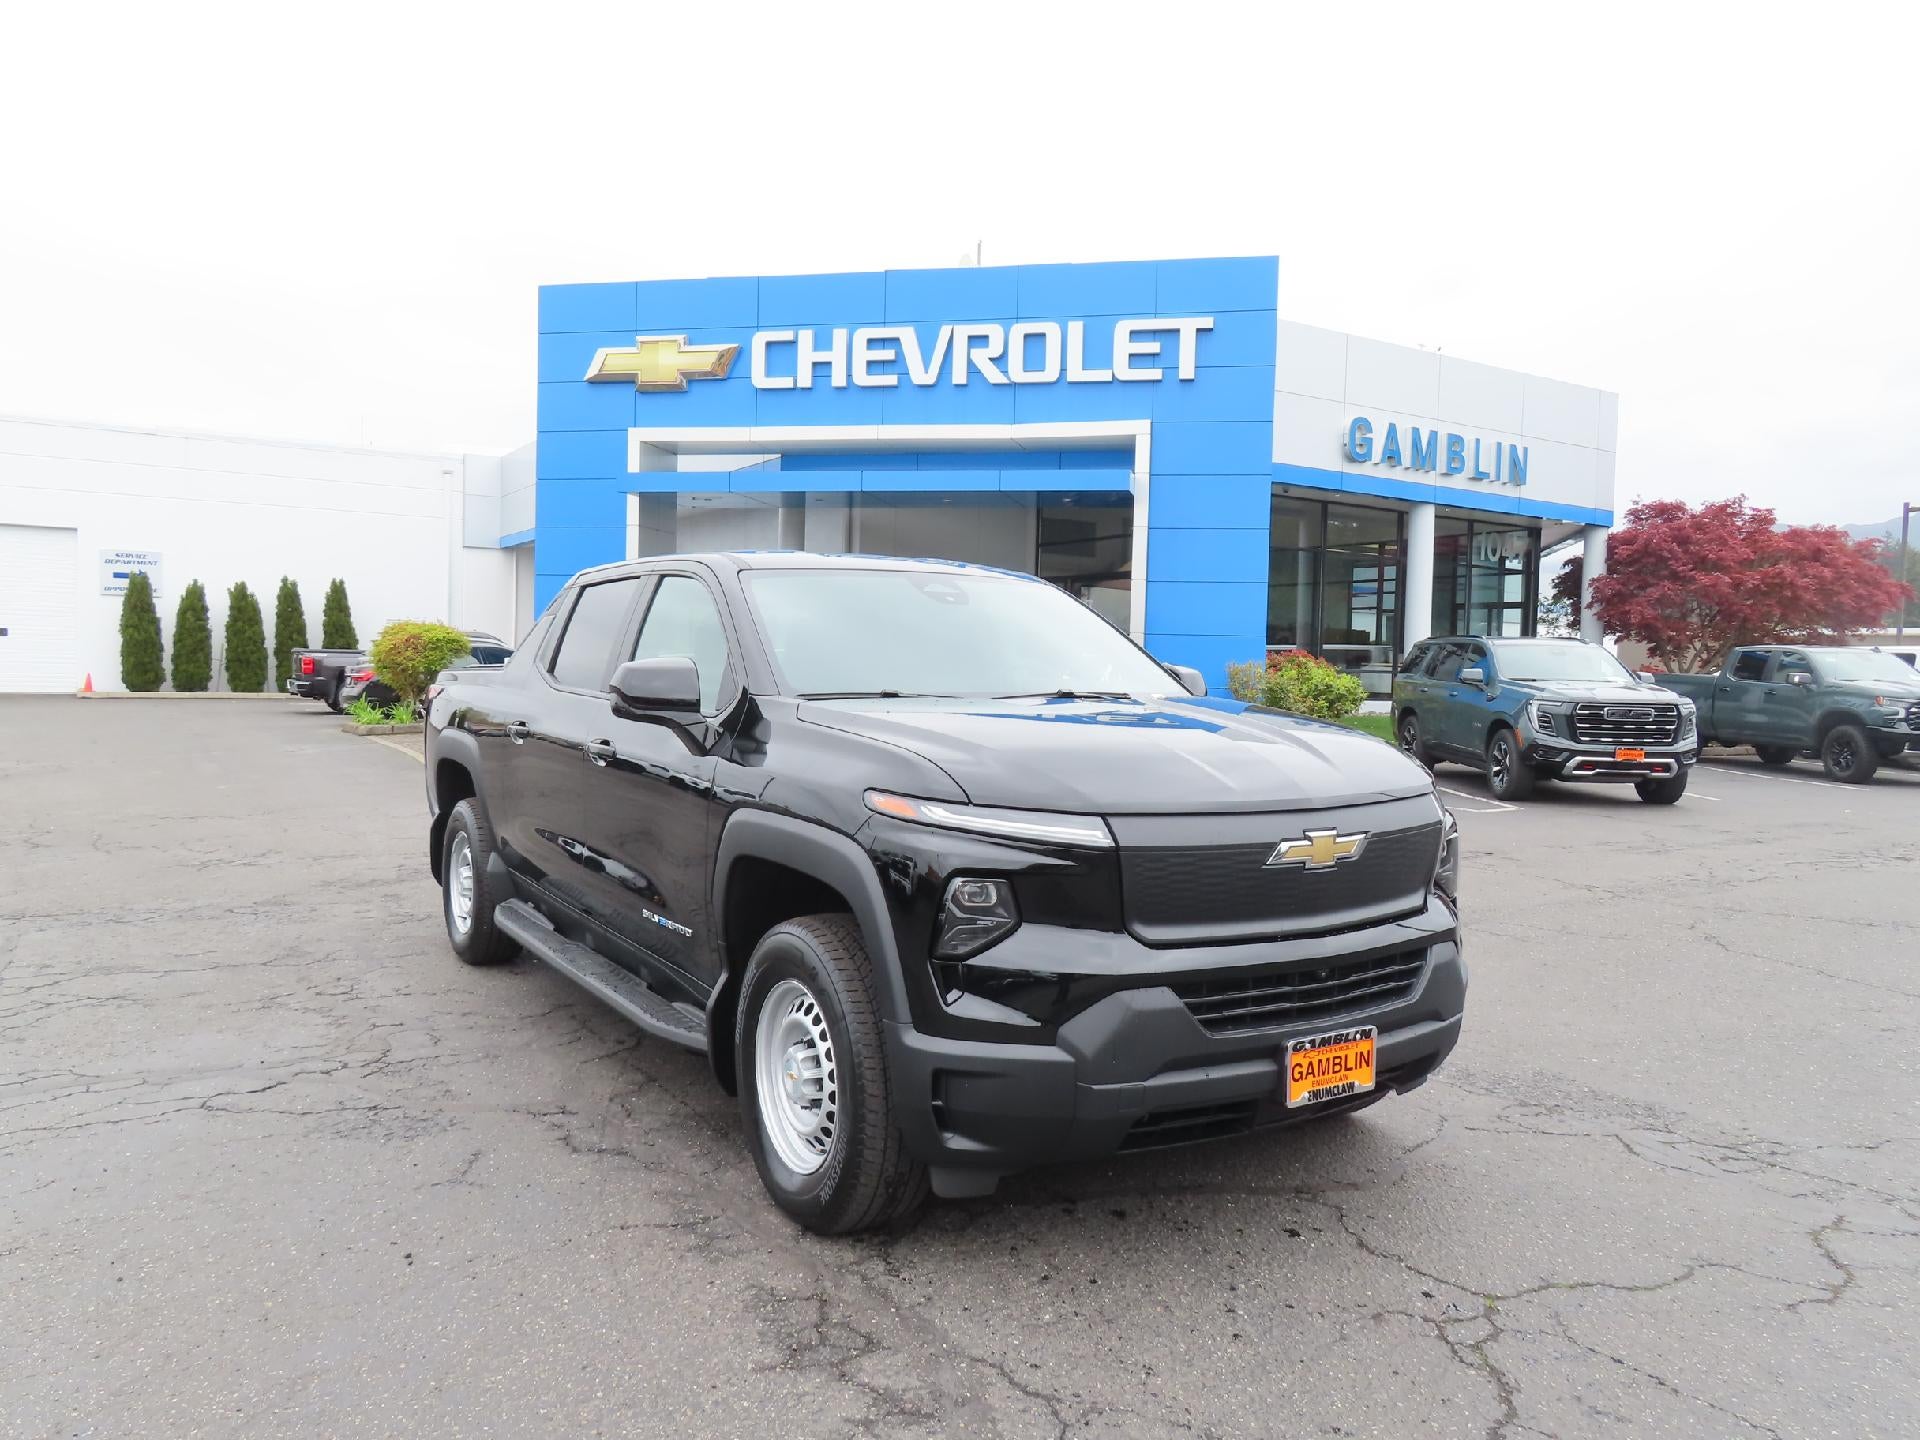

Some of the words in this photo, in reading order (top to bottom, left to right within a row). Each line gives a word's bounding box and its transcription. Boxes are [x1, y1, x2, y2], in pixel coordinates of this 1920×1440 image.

[751, 317, 1214, 389] CHEVROLET
[1345, 416, 1528, 486] GAMBLIN
[104, 558, 159, 566] DEPARTMENT
[642, 908, 693, 937] SILVERADO
[1292, 1028, 1372, 1052] GAMBLIN
[1291, 1050, 1370, 1082] GAMBLIN
[1307, 1082, 1355, 1102] ENUMCLAW
